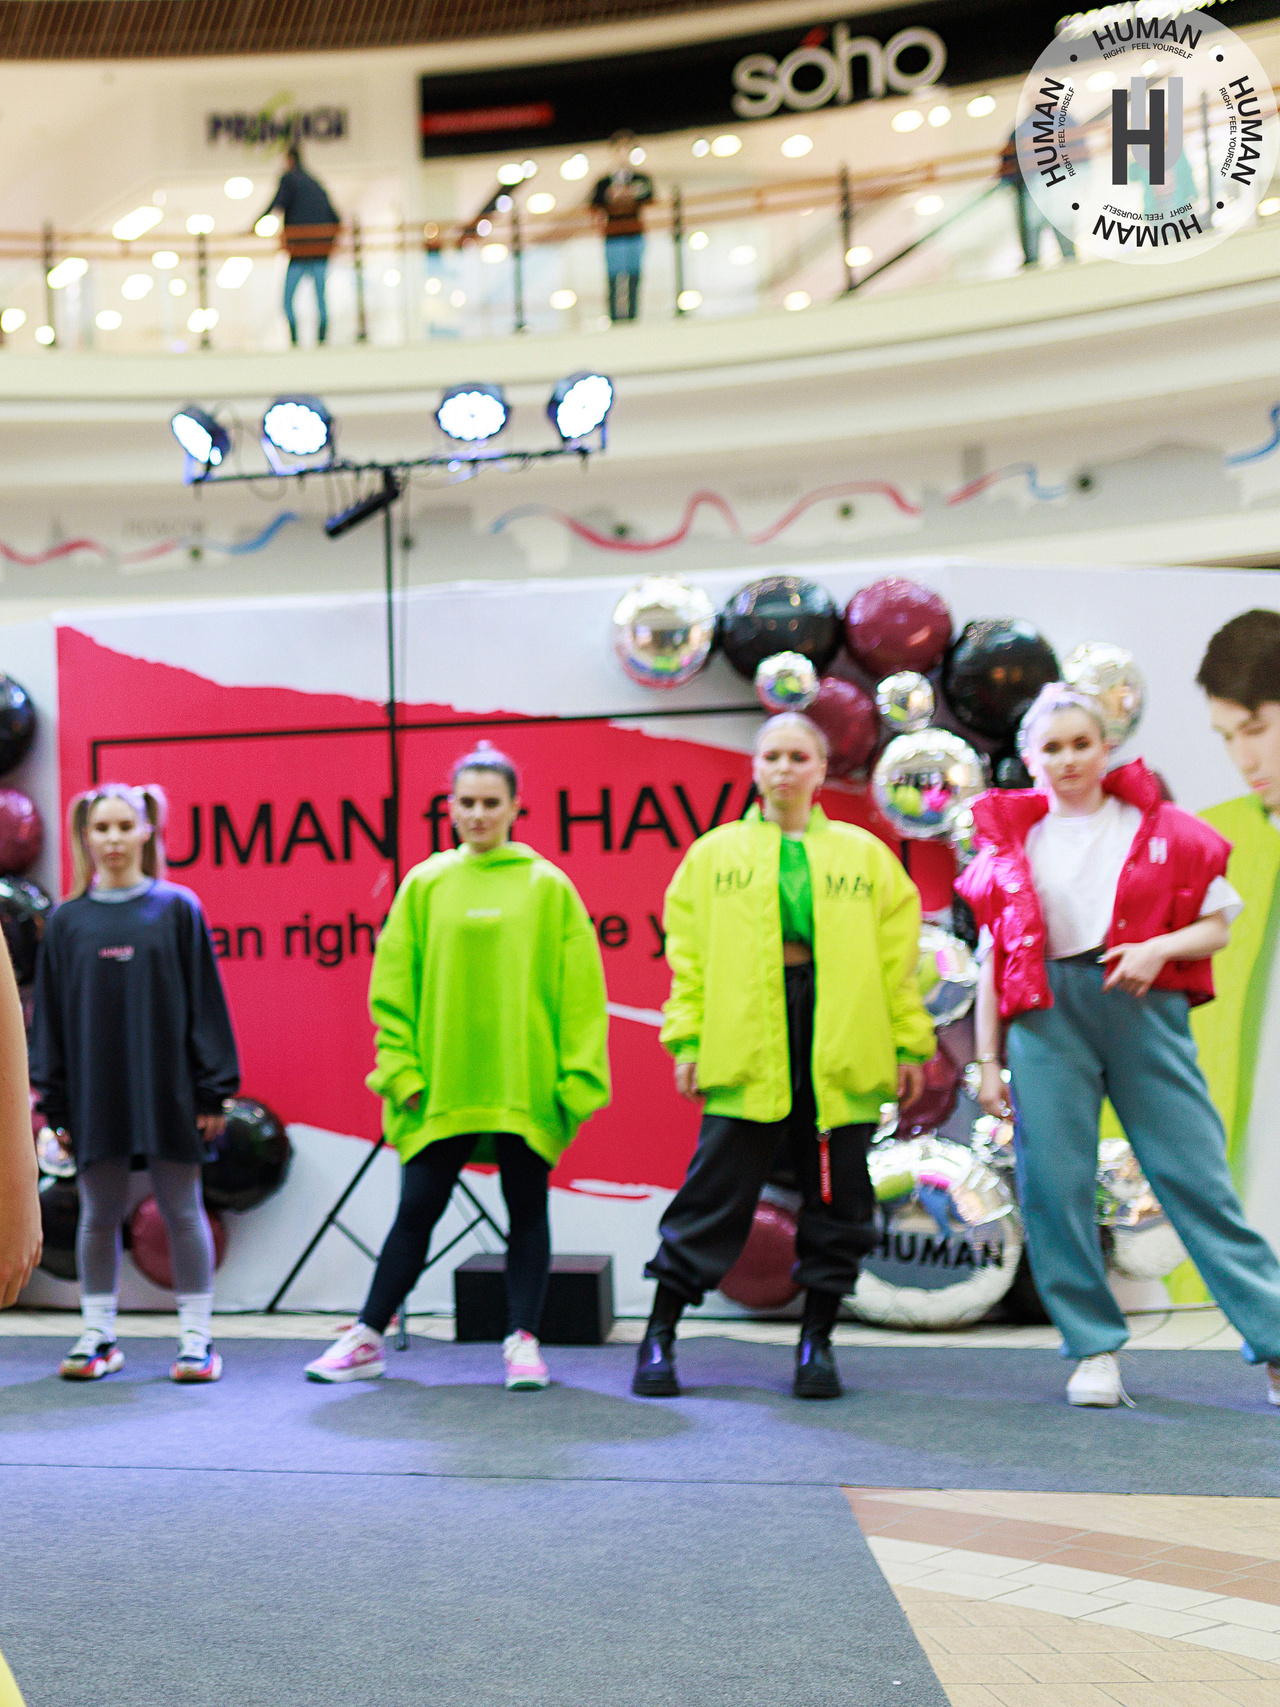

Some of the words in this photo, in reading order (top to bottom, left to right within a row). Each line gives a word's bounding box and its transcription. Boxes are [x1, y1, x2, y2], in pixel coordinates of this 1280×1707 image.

[165, 799, 398, 868] UMAN
[556, 782, 764, 854] HAV
[284, 912, 389, 968] righ
